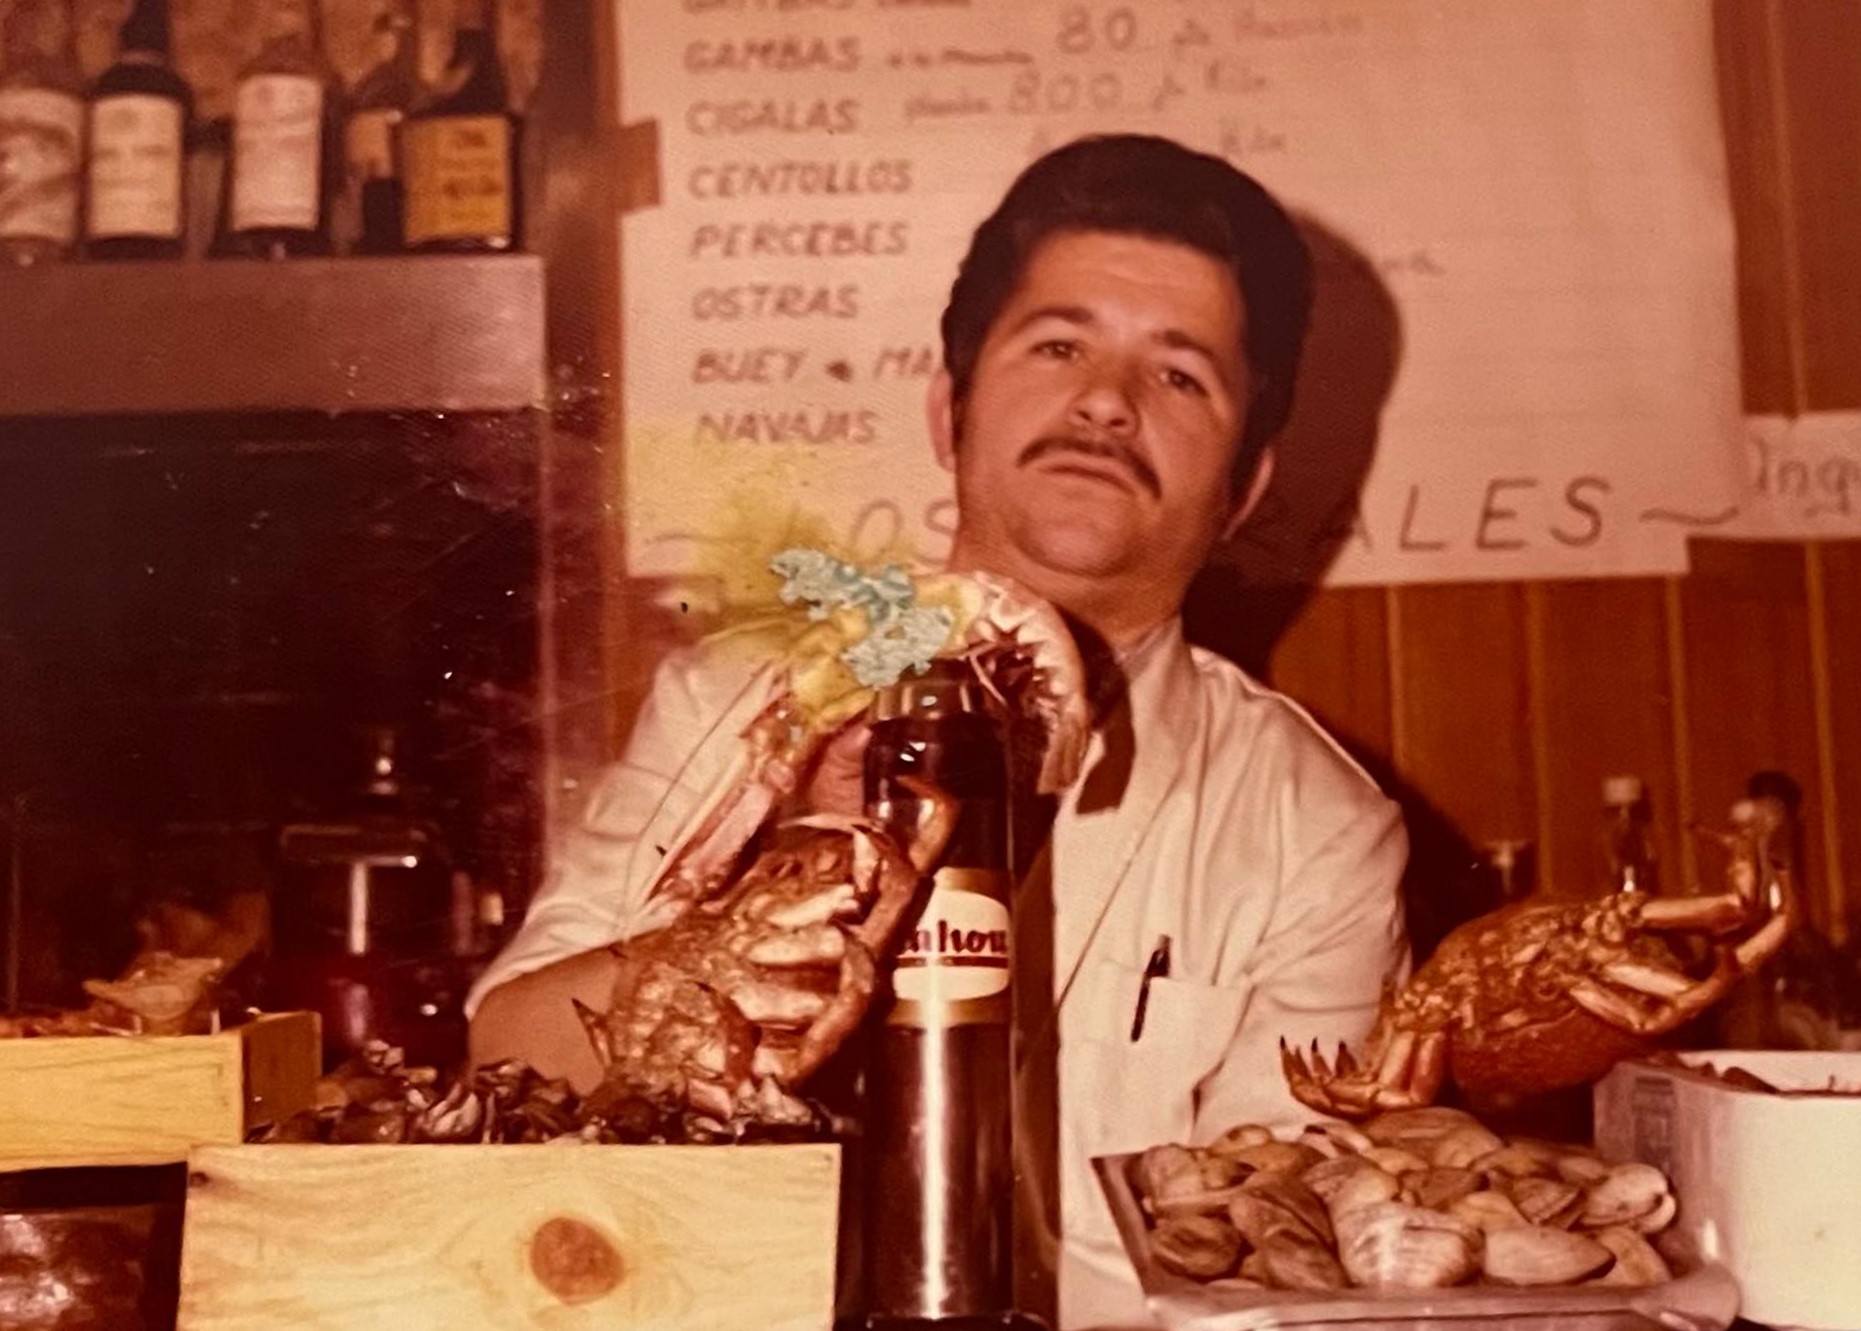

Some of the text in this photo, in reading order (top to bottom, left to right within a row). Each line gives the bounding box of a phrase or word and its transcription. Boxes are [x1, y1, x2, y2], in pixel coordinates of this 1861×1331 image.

[683, 38, 859, 72] GAMBAS
[1055, 7, 1137, 54] 80
[685, 99, 860, 134] CIGALAS
[688, 158, 913, 198] CENTOLLOS
[690, 221, 909, 257] PERCEBES
[693, 284, 860, 320] OSTRAS
[693, 346, 805, 384] BUEY
[694, 408, 880, 446] NAVAJAS
